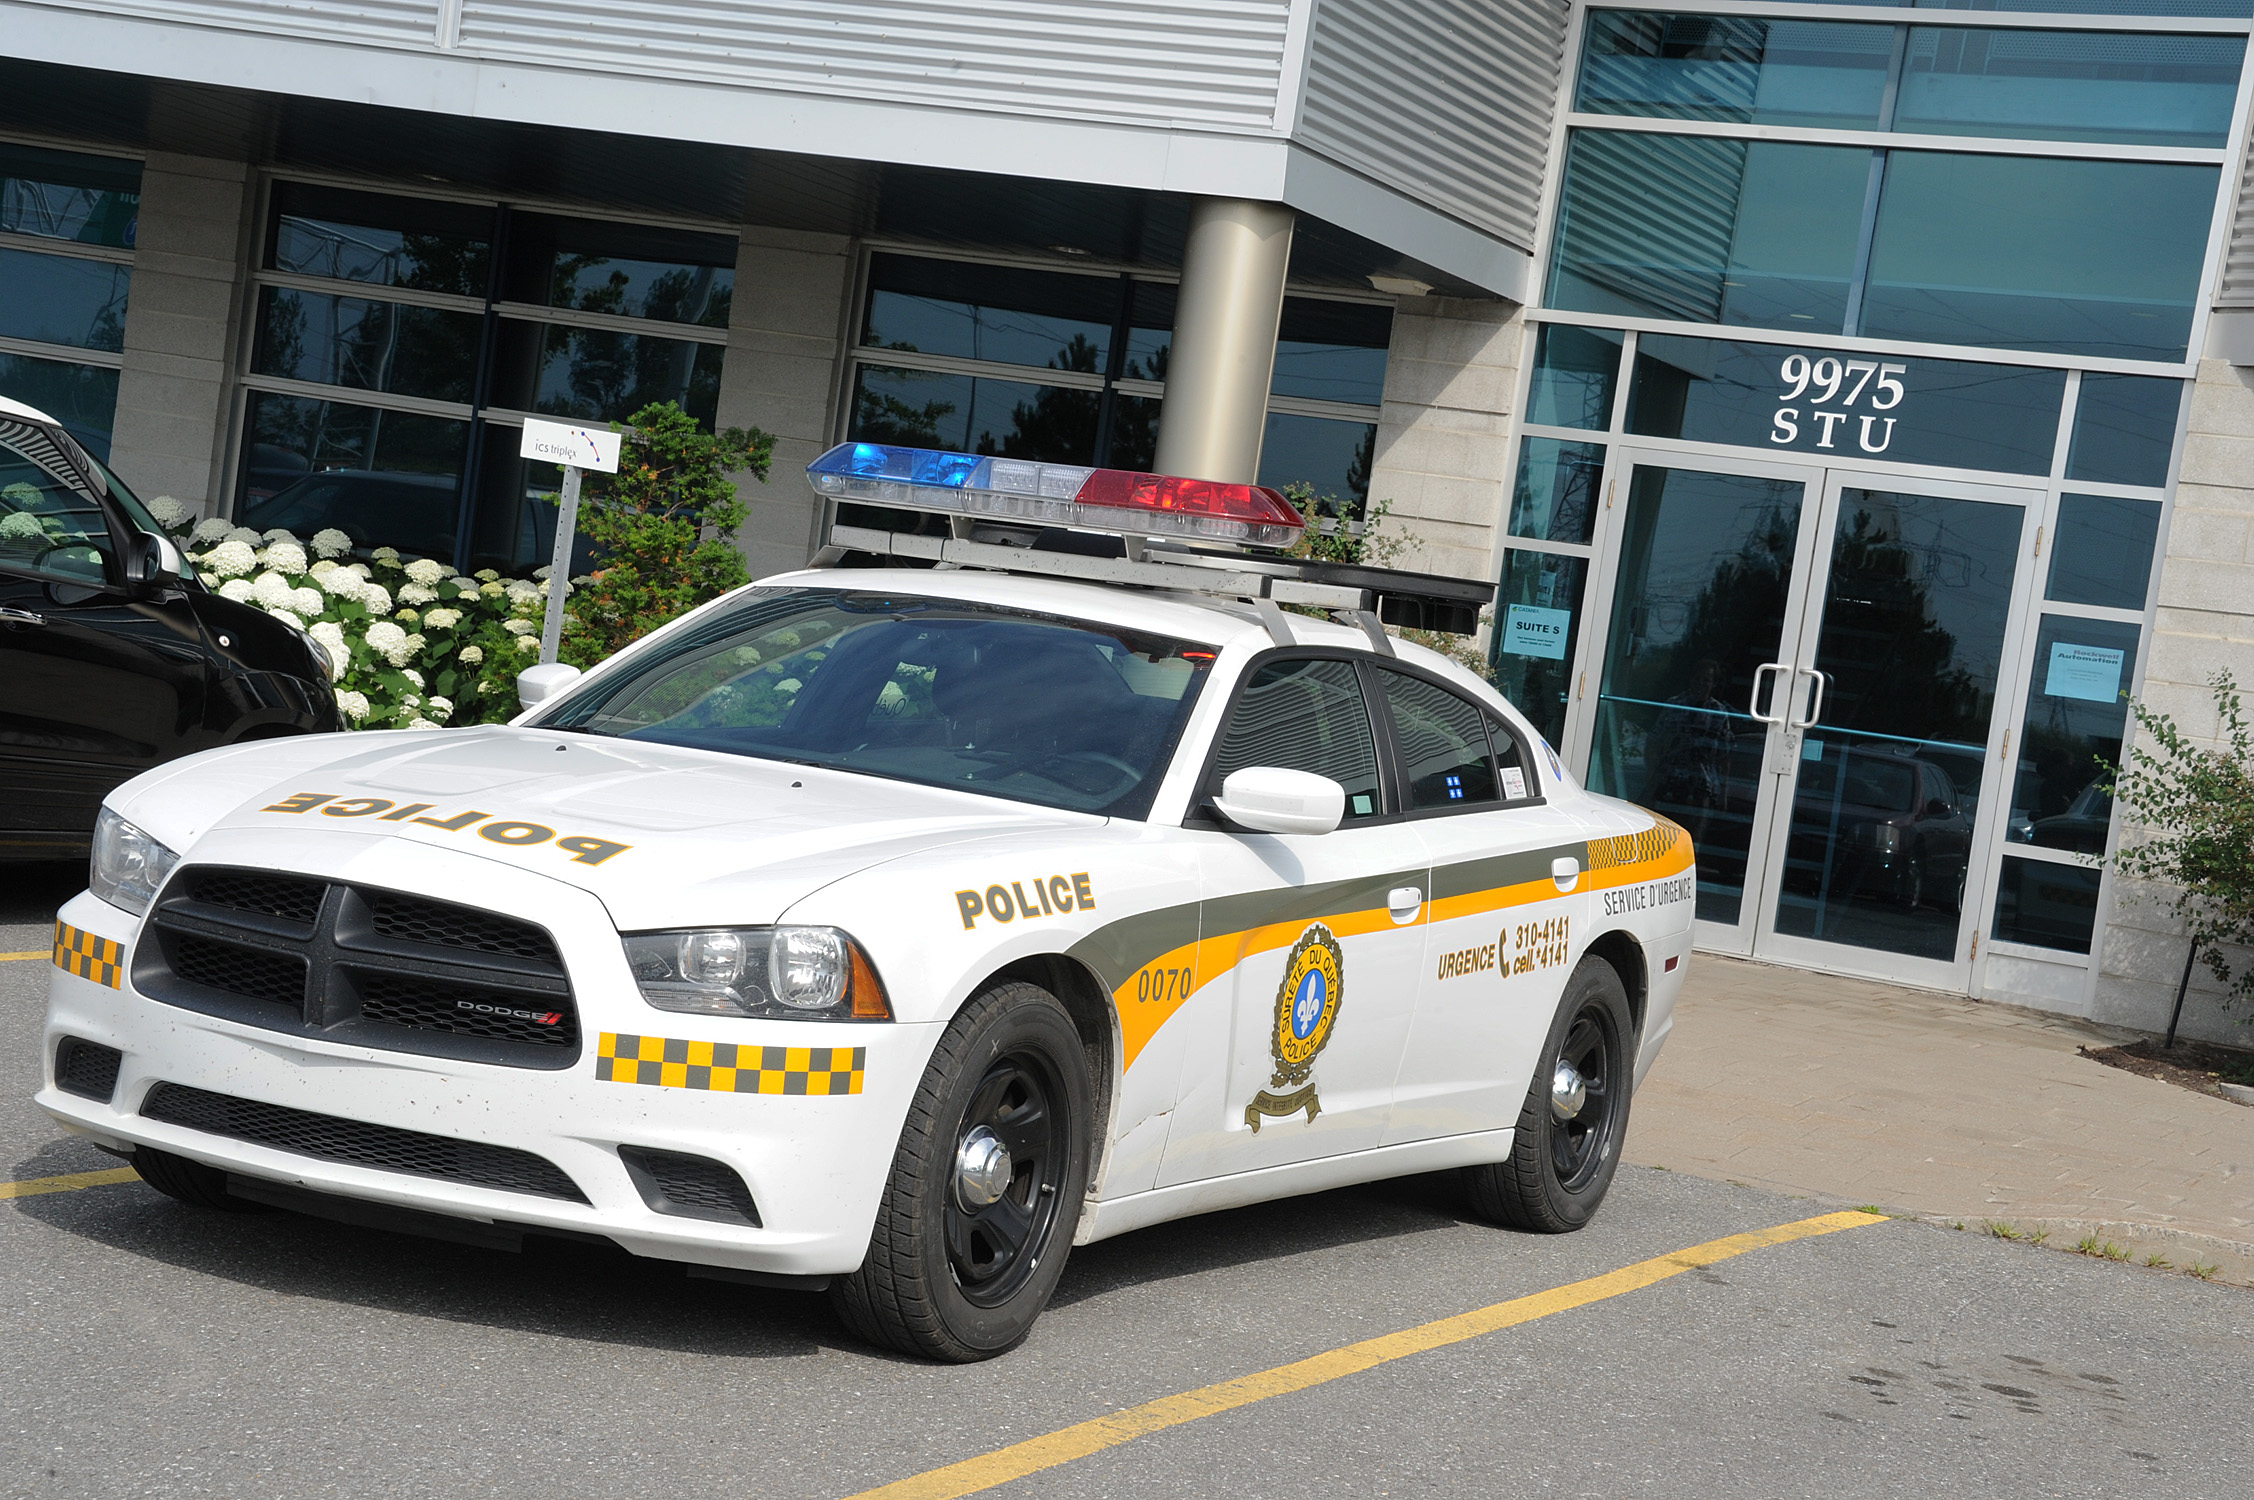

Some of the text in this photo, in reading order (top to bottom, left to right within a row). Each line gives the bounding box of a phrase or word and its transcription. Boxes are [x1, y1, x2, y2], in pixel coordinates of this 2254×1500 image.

[1779, 354, 1907, 410] 9975
[535, 439, 577, 457] ics triplex
[1770, 408, 1897, 453] S T U
[1516, 621, 1560, 635] SUITE S
[2057, 653, 2118, 665] Automation
[2073, 650, 2119, 660] Rockwell
[955, 871, 1096, 931] POLICE
[1603, 876, 1692, 917] SERVICE D'URGENCE
[1515, 915, 1570, 950] 310-4141
[1437, 943, 1496, 981] URGENCE
[1138, 967, 1192, 1003] 0070
[1309, 949, 1322, 965] DU
[1320, 957, 1337, 1029] QUÉBEC
[457, 1001, 549, 1020] DODGE
[1283, 1033, 1317, 1059] POLICE
